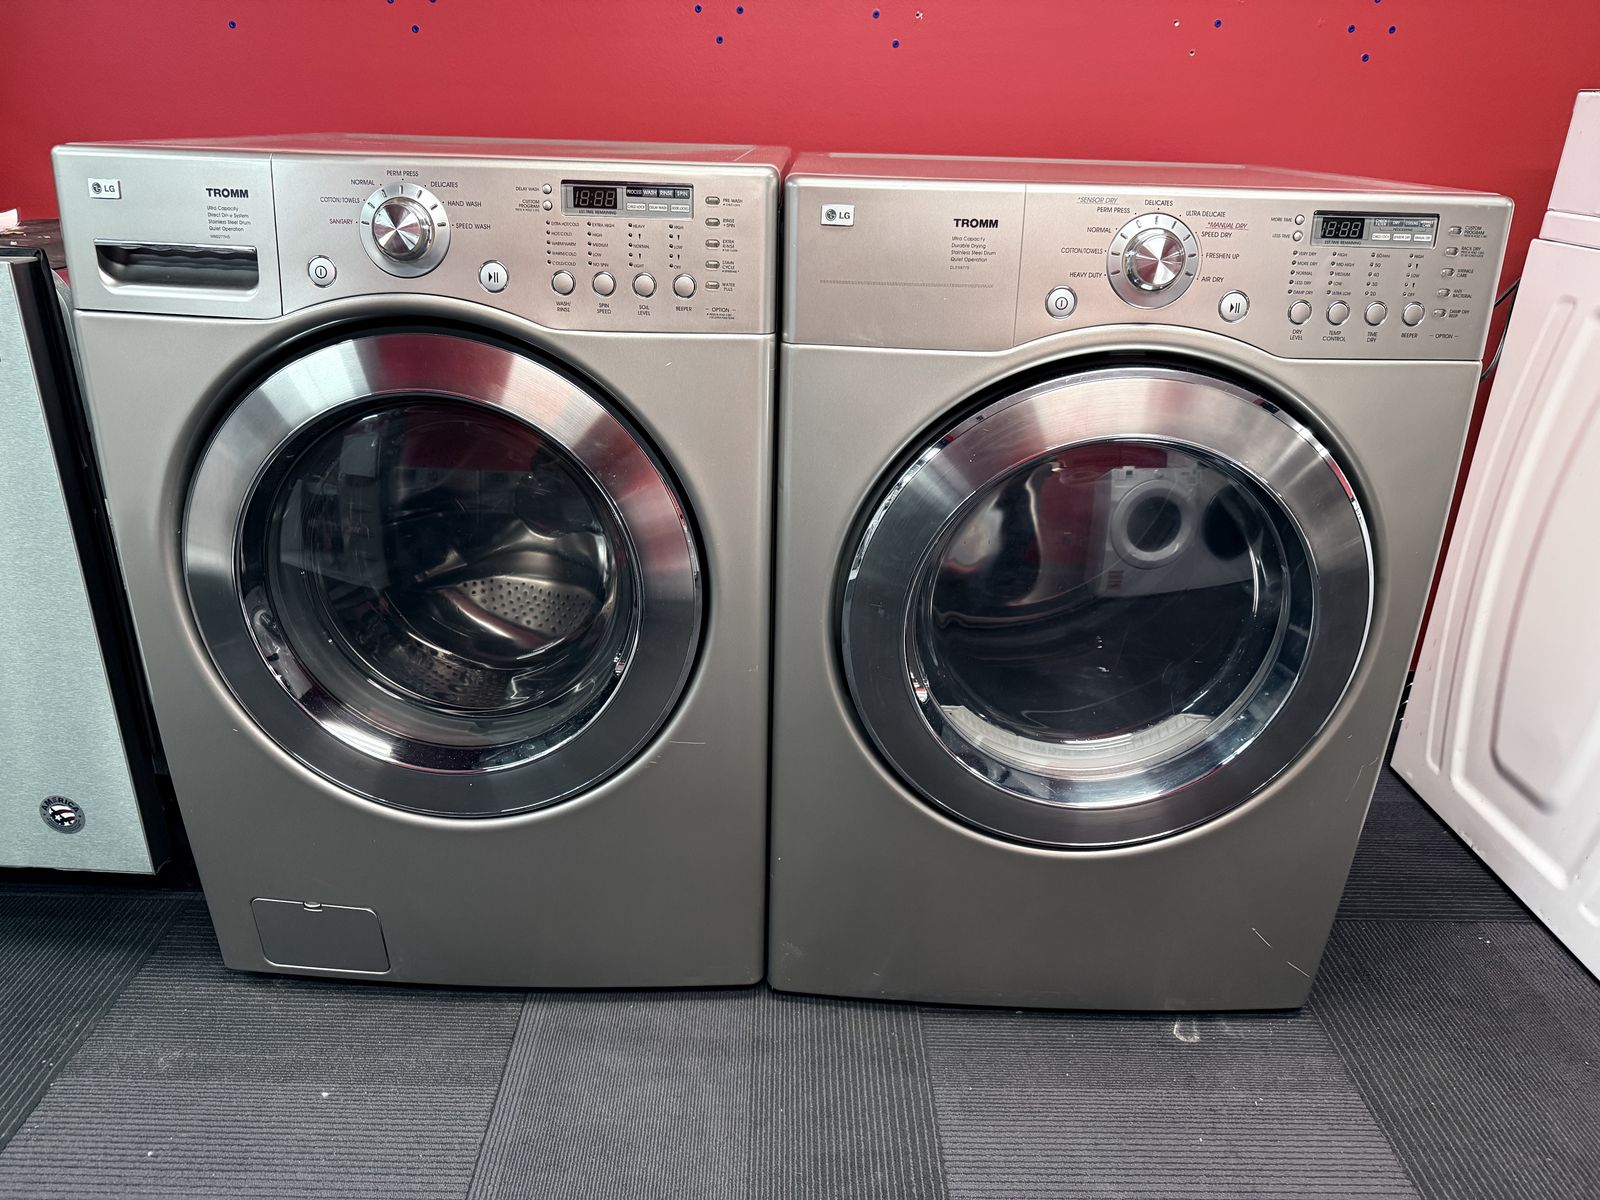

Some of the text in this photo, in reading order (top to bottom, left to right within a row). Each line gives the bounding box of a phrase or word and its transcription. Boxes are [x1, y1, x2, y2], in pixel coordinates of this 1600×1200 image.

[104, 185, 116, 193] LG
[206, 188, 249, 198] TROMM
[838, 211, 851, 219] LG
[953, 218, 999, 228] TROMM
[40, 796, 79, 812] AMERICA
